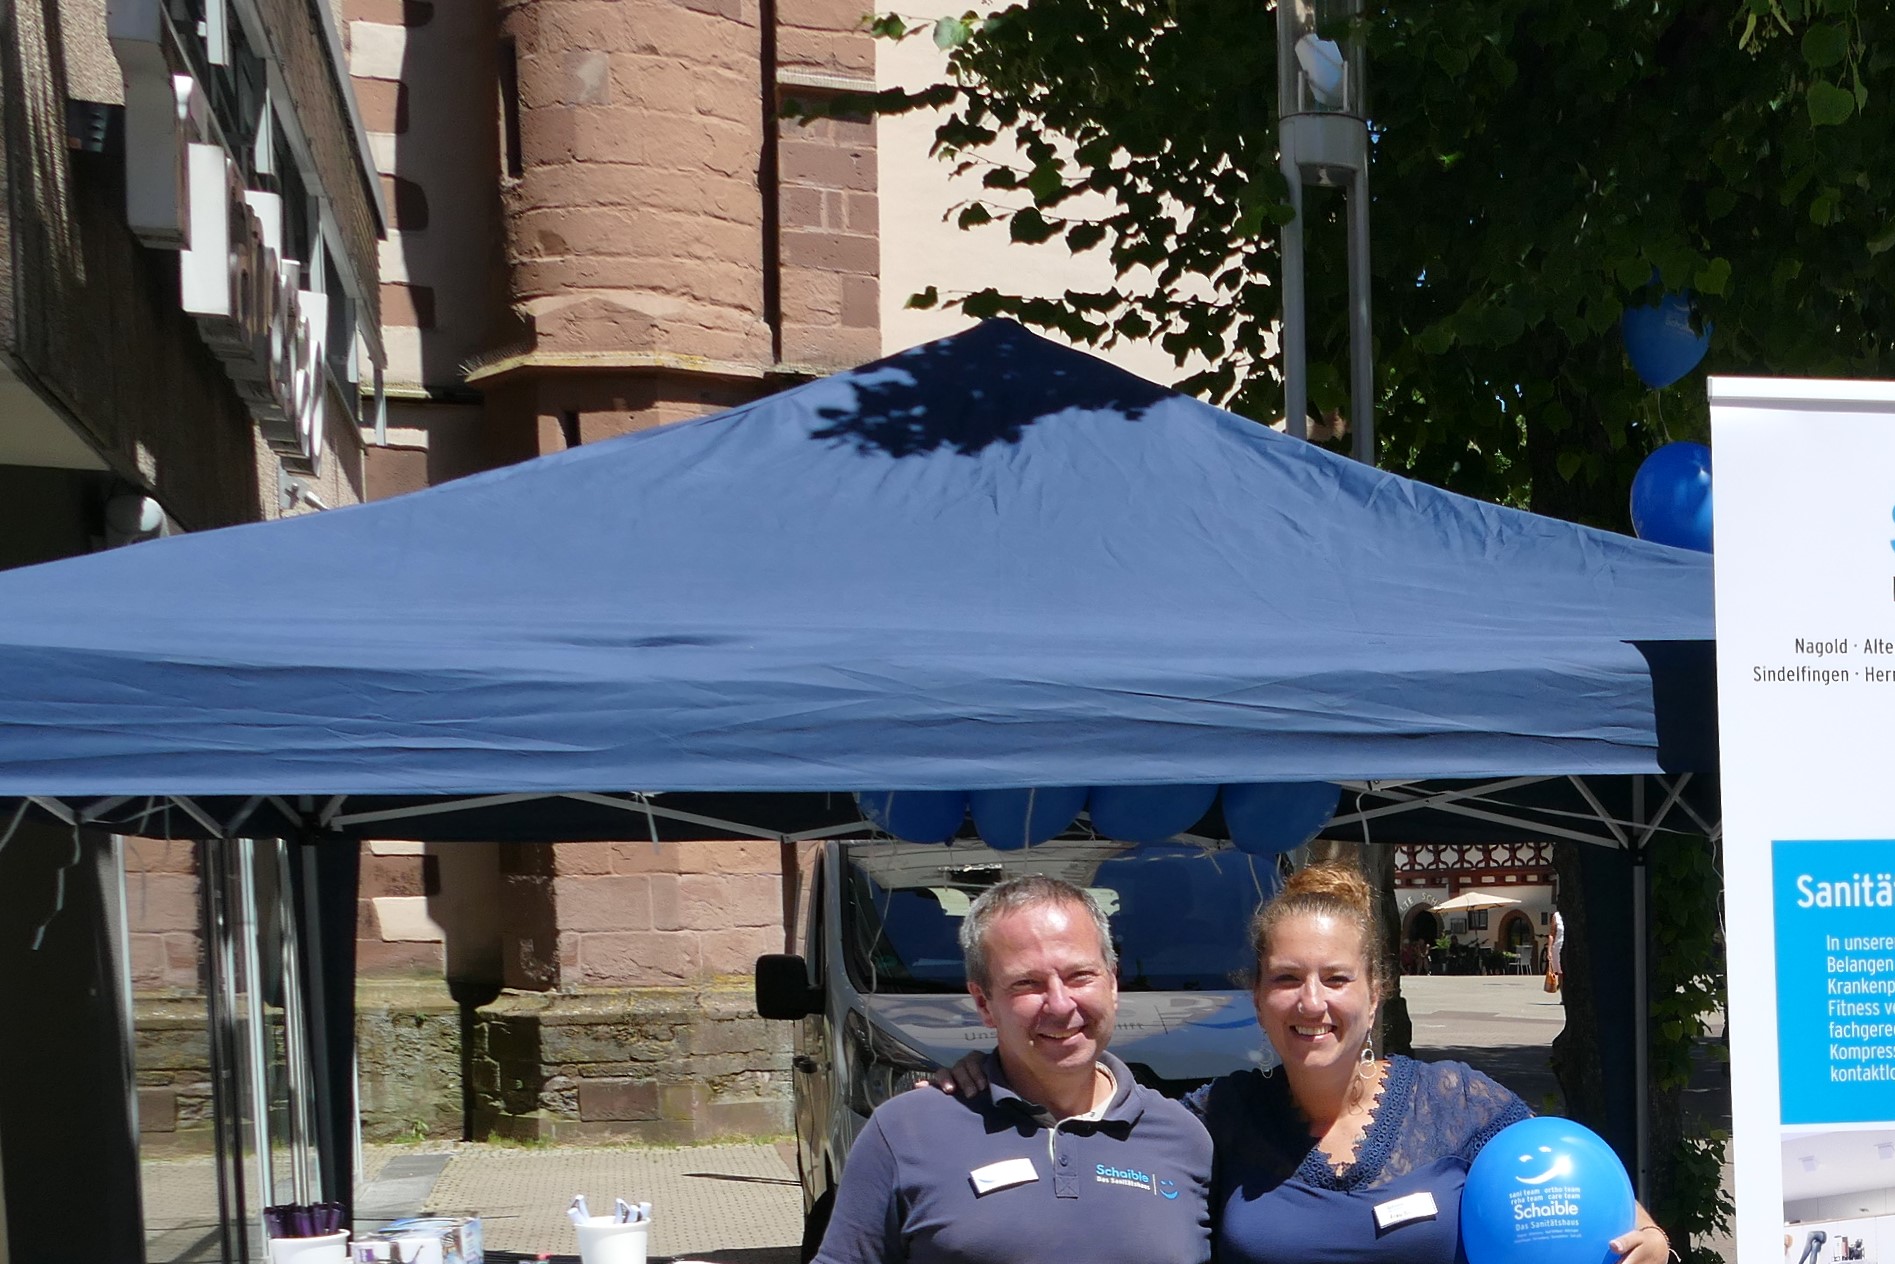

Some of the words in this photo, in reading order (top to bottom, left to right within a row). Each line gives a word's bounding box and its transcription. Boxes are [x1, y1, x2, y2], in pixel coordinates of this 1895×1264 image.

[1795, 637, 1848, 658] Nagold
[1753, 665, 1849, 686] Sindelfingen
[1826, 934, 1841, 951] In
[1826, 955, 1895, 976] Belangen
[1828, 999, 1881, 1017] Fitness
[1096, 1164, 1149, 1183] Schaible
[1514, 1199, 1579, 1220] Schaible
[1515, 1223, 1529, 1231] Das
[1530, 1218, 1579, 1229] Sanitätshaus
